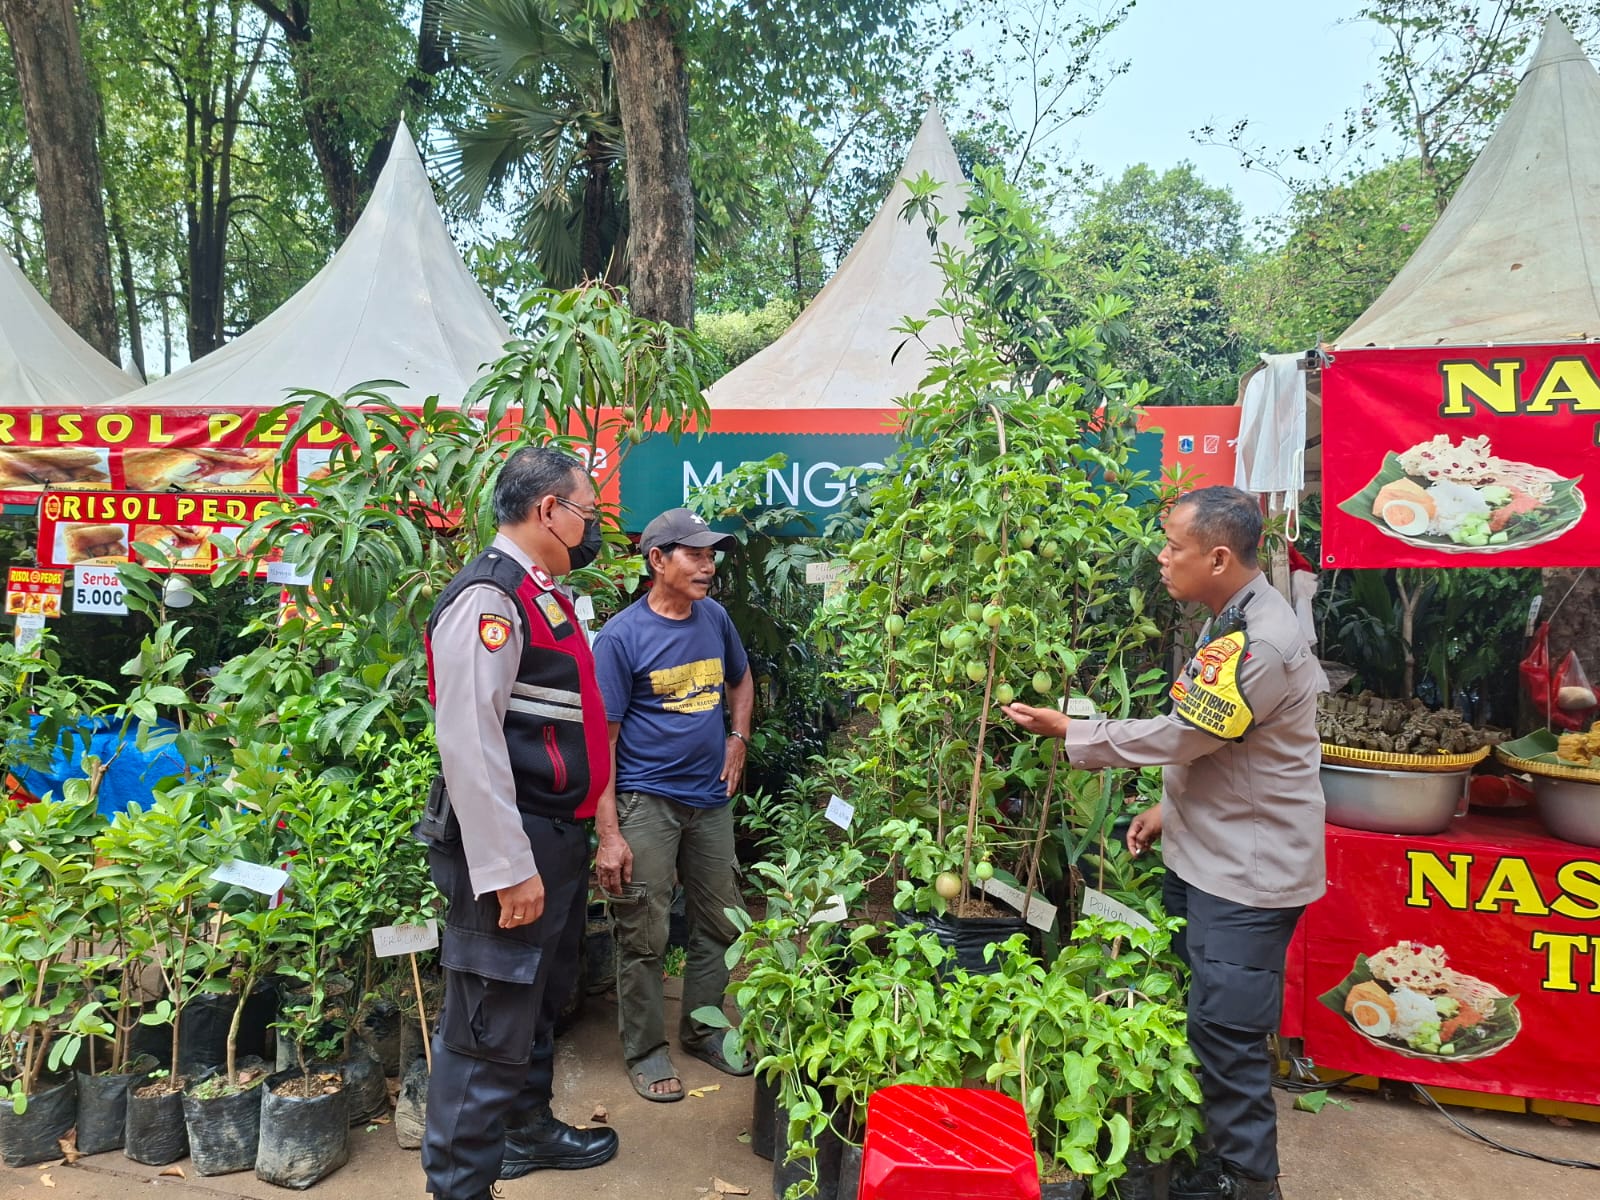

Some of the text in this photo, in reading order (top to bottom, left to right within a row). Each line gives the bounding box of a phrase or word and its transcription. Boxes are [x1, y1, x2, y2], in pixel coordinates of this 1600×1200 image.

[62, 496, 162, 520] RISOL
[83, 572, 119, 587] Serba
[1197, 712, 1226, 733] BESAR
[1202, 705, 1226, 723] BARU
